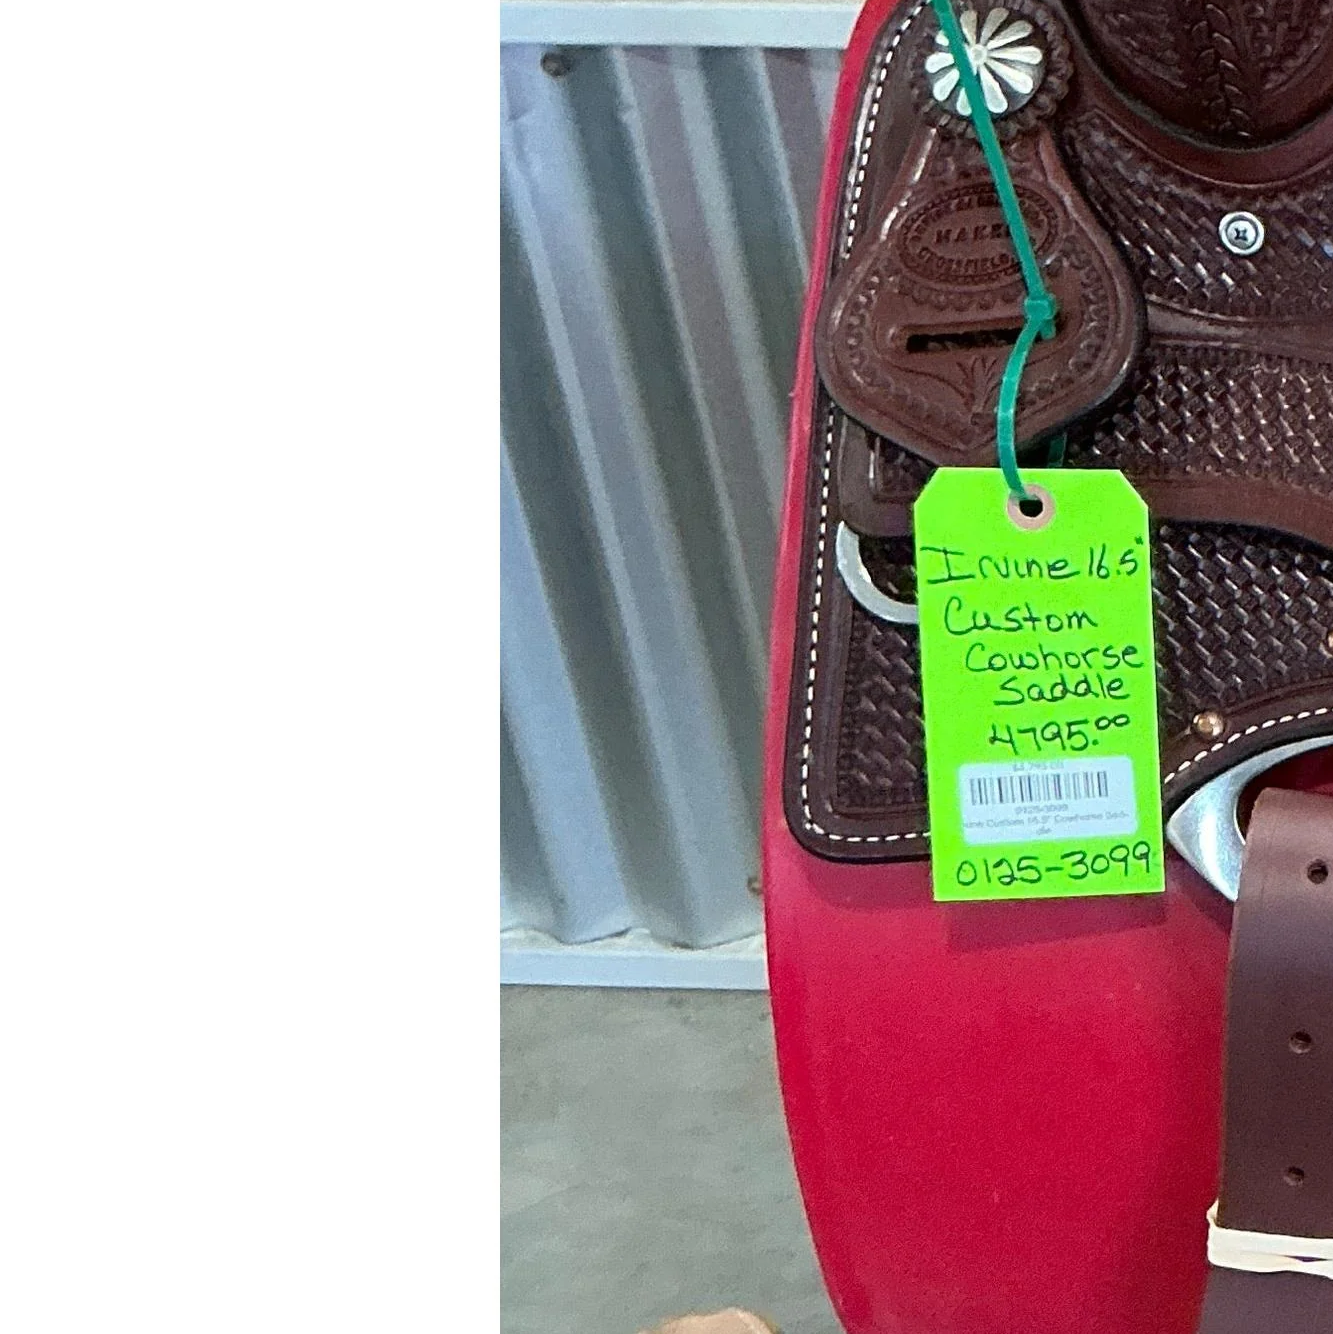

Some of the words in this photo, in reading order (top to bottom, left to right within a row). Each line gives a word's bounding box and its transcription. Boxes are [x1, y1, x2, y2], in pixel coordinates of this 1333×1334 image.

[920, 547, 1080, 584] Irvine
[944, 595, 1098, 635] Custom
[965, 642, 1144, 672] Cowhorse
[993, 673, 1130, 706] Saddle
[956, 840, 1151, 886] 0125-3099
